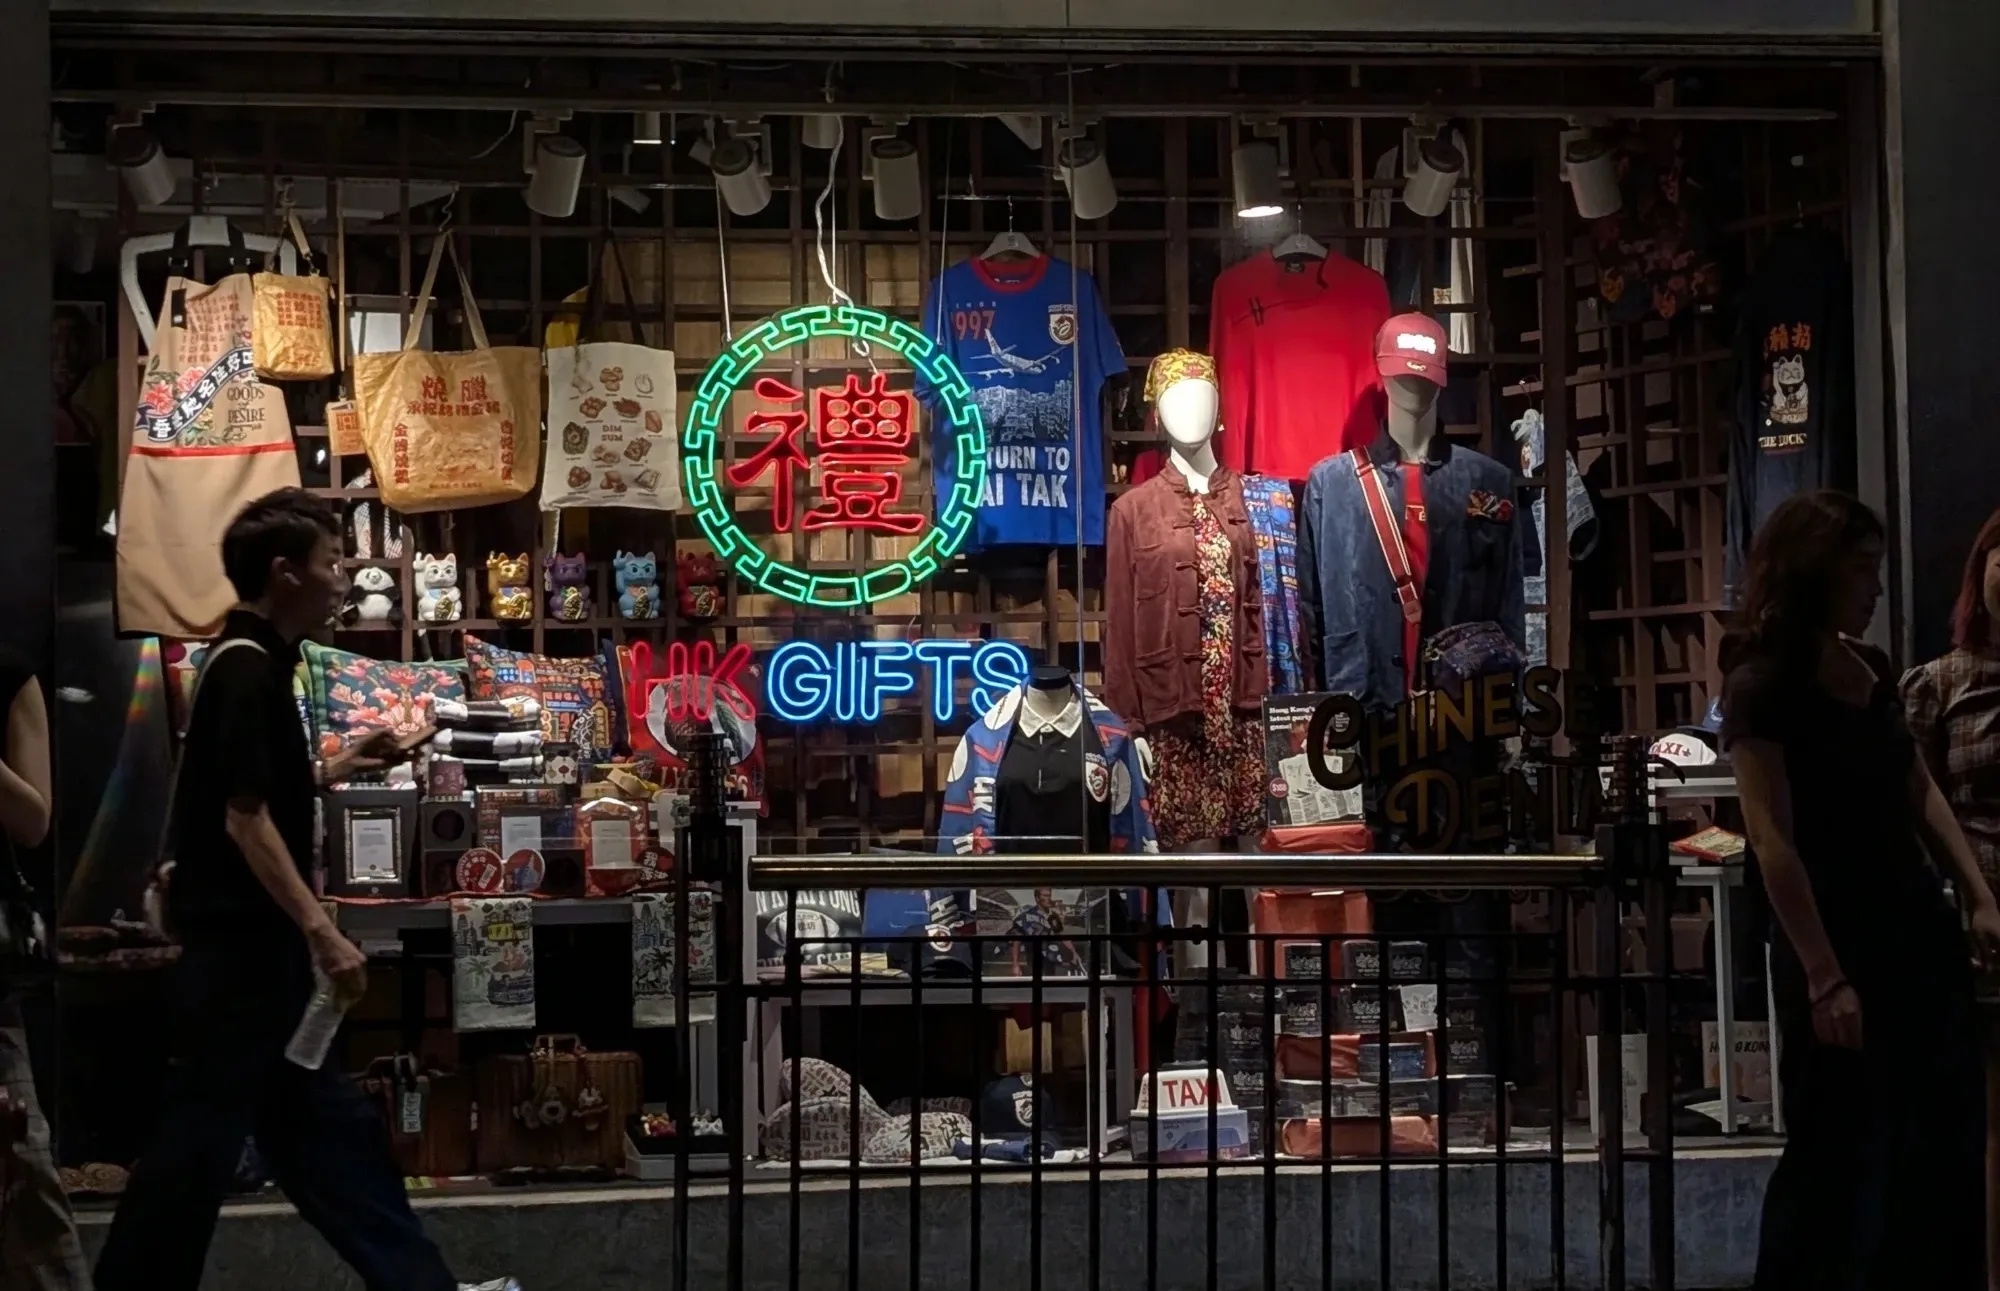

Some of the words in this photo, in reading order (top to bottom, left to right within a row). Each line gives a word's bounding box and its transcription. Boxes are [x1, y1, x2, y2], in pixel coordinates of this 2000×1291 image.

[950, 309, 996, 341] 997
[226, 385, 266, 401] GOODS
[227, 407, 267, 424] DESIRE
[602, 424, 623, 433] DIM
[601, 433, 624, 442] SUM
[727, 372, 926, 534] 禮
[986, 445, 1036, 470] TURN
[1043, 446, 1071, 472] TO
[979, 473, 1004, 507] AI
[1015, 472, 1069, 508] TAK
[630, 639, 757, 721] HK
[766, 639, 1031, 722] GIFTS
[1269, 706, 1289, 715] Hong
[1290, 705, 1316, 714] Kong's
[1307, 665, 1603, 791] CHINESE
[1162, 1078, 1223, 1108] TAXI
